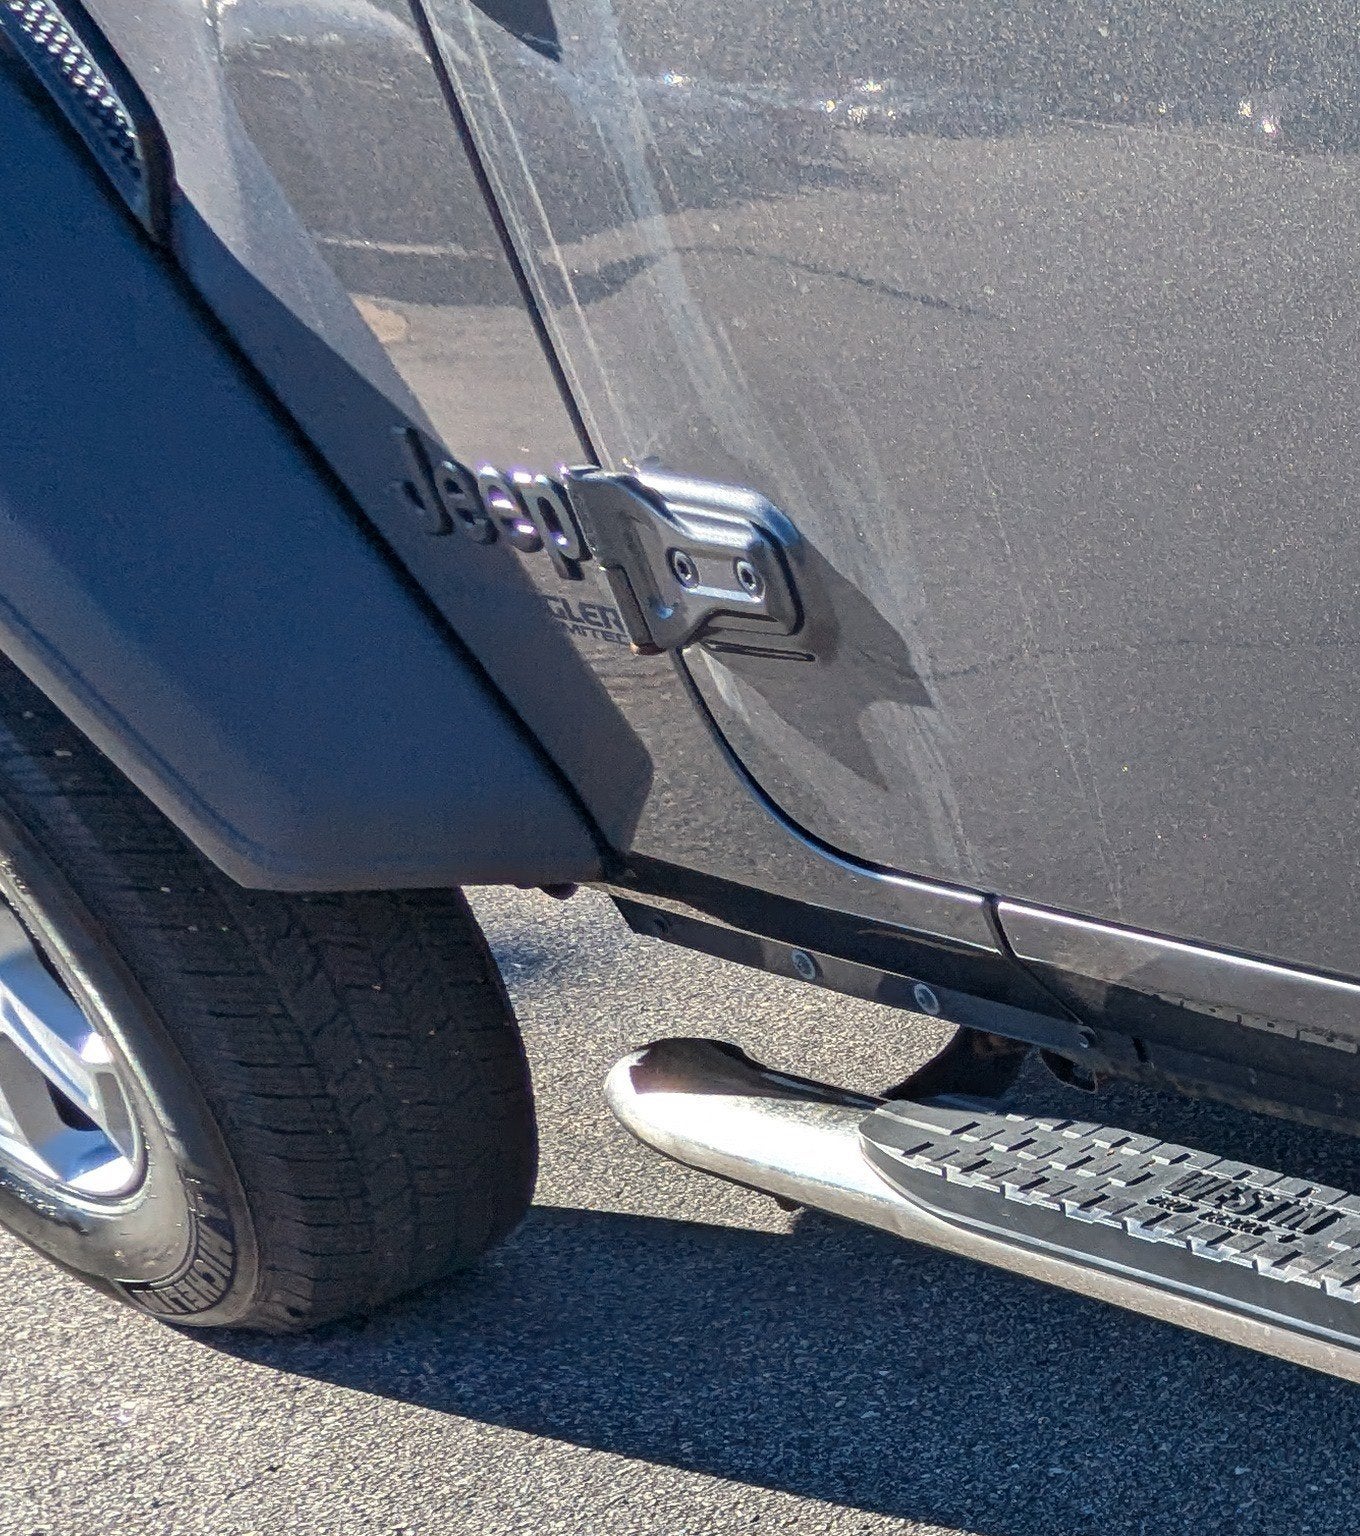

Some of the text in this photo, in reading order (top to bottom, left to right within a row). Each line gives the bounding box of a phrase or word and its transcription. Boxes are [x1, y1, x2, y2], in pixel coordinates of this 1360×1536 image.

[397, 427, 586, 580] Jeep
[1162, 1169, 1340, 1235] WESTIN
[132, 1219, 234, 1315] MICHELIN
